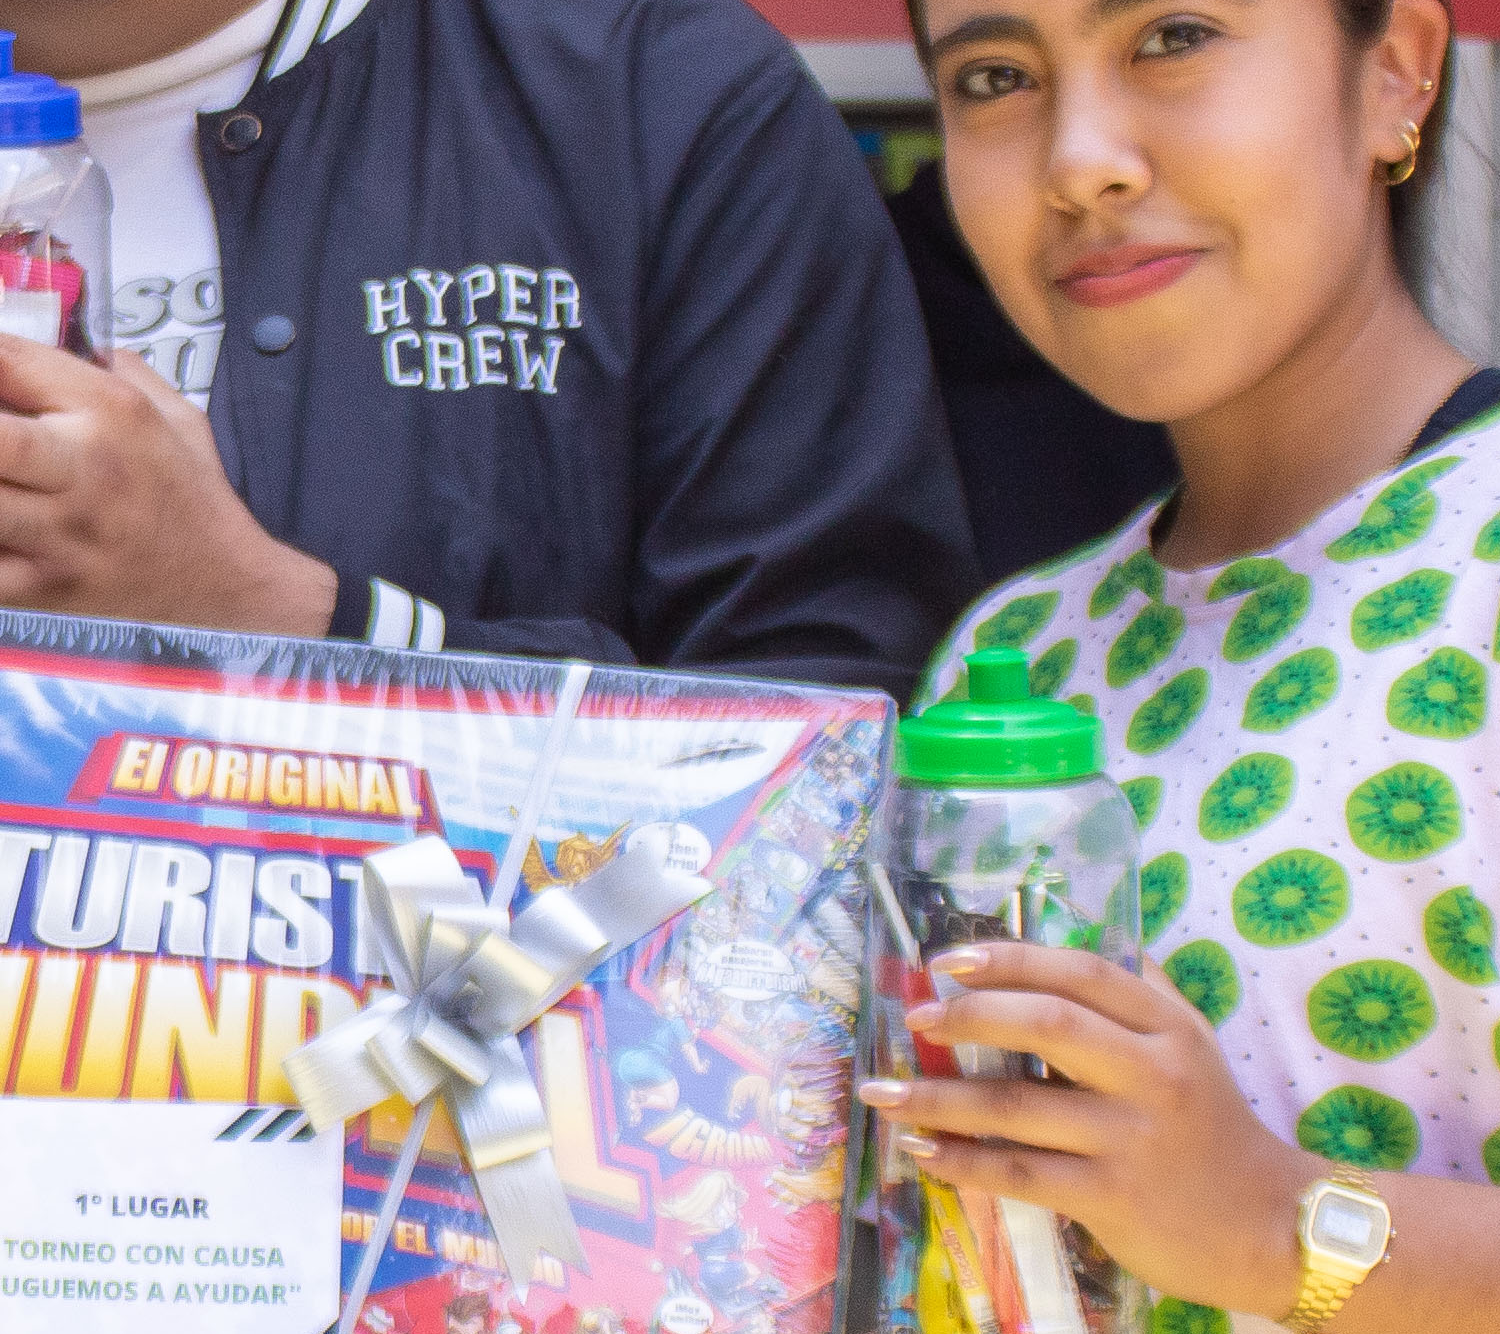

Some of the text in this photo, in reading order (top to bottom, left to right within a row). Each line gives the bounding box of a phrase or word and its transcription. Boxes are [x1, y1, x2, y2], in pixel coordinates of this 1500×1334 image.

[362, 263, 582, 334] HYPER
[382, 324, 566, 394] CREW
[176, 746, 424, 819] ORIGINAL
[111, 1195, 210, 1220] LUGAR
[4, 1238, 285, 1269] TORNEO CON CAUSA
[395, 1220, 435, 1256] EL
[146, 1279, 165, 1303] A
